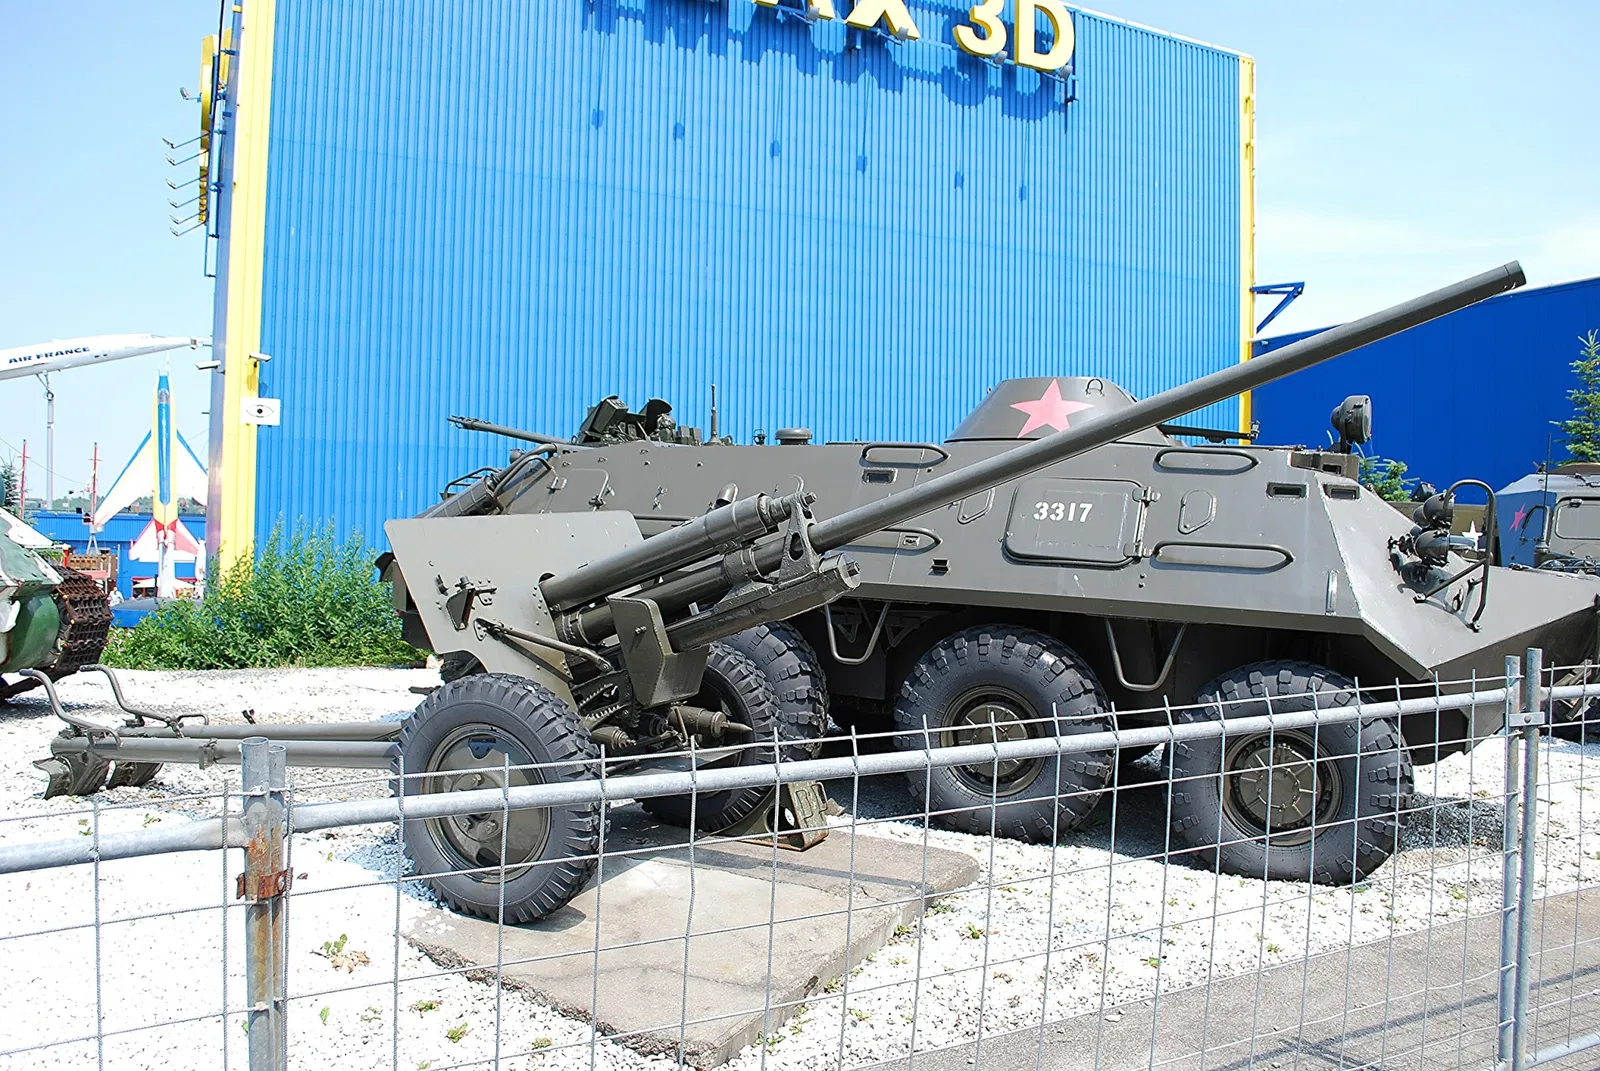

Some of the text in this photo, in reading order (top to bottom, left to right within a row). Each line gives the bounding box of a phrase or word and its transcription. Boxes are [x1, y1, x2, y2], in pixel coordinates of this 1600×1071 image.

[953, 0, 1075, 72] 3D
[9, 346, 90, 364] AIR FRANCE
[1033, 501, 1093, 523] 3317
